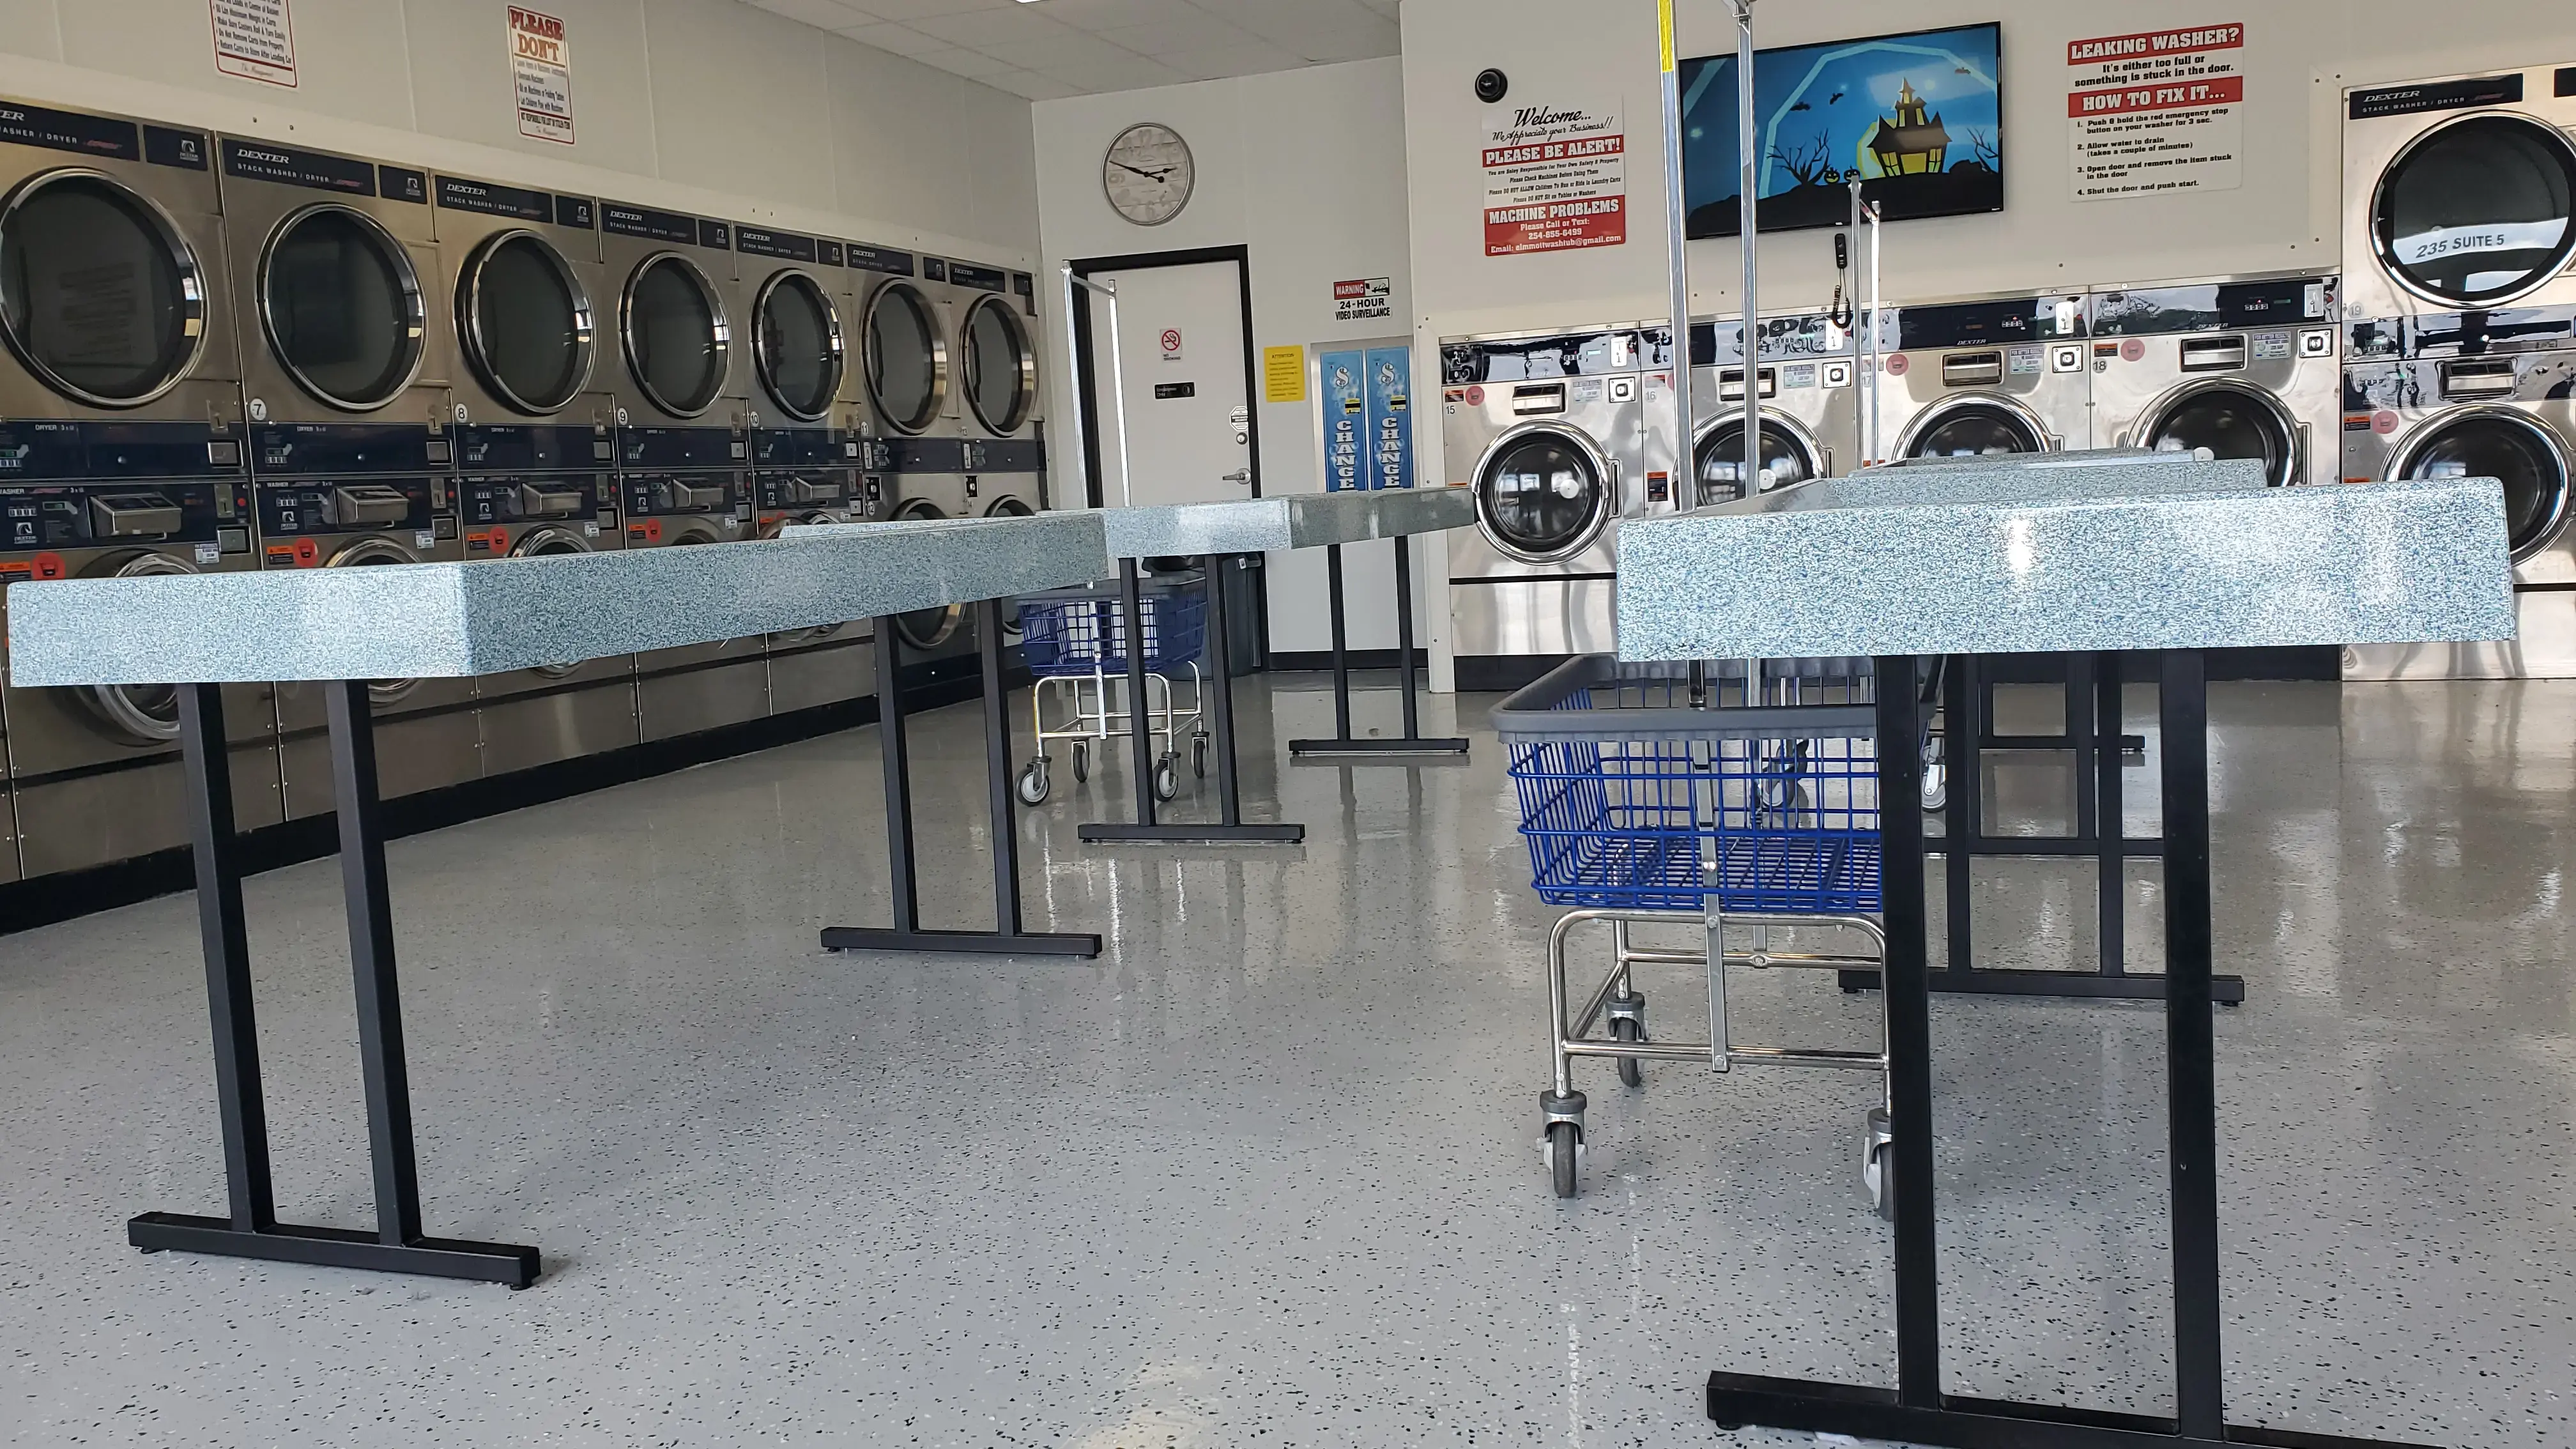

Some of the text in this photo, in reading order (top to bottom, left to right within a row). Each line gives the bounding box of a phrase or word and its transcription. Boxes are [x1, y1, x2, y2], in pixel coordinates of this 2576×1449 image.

[510, 9, 563, 40] PLEASE
[518, 33, 558, 61] DON'T
[2071, 27, 2239, 59] LEAKING WASHER?
[2103, 64, 2119, 73] It's
[2122, 61, 2152, 72] either
[2155, 59, 2171, 68] too
[2174, 56, 2191, 65] full
[2075, 64, 2234, 87] something is stuck in the door.
[2083, 85, 2225, 111] HOW TO FIX IT...
[2363, 90, 2420, 102] DEXTER
[2362, 105, 2389, 113] STACK
[2393, 102, 2427, 110] WASHER
[1514, 105, 1591, 128] Welcome...
[2088, 118, 2106, 126] Push
[2166, 110, 2209, 119] emergency
[47, 133, 77, 144] DRYER
[1492, 132, 1505, 141] We
[1501, 127, 1547, 146] Appreciate
[1549, 128, 1566, 142] your
[1485, 137, 1620, 165] PLEASE BE ALERT!
[2120, 146, 2146, 155] couple
[2158, 142, 2193, 150] minutes)
[236, 148, 289, 164] DEXTER
[237, 163, 263, 173] STACK
[266, 167, 297, 178] WASHER
[306, 174, 329, 183] DRYER
[447, 183, 487, 196] DEXTER
[447, 196, 466, 204] STACK
[468, 199, 492, 208] WASHER
[610, 210, 643, 221] DEXTER
[1489, 199, 1619, 224] MACHINE PROBLEMS
[1520, 222, 1544, 231] Please
[1546, 220, 1560, 229] Call
[1572, 218, 1590, 226] Text:
[743, 232, 770, 242] DEXTER
[2416, 234, 2504, 258] 235 SUITE 5
[853, 249, 876, 258] DEXTER
[1336, 284, 1363, 296] WARNING
[1340, 298, 1384, 309] 24-HOUR
[2350, 305, 2361, 315] 19
[1335, 307, 1390, 321] VIDEO SURVEILLANCE
[2092, 361, 2106, 371] 18
[1645, 391, 1657, 400] 16
[253, 403, 262, 416] 7
[458, 408, 465, 419] 8
[620, 411, 625, 421] 9
[1446, 405, 1455, 415] 15
[751, 415, 758, 424] 10
[862, 425, 868, 433] 11
[1335, 420, 1355, 489] CHANGE
[1380, 417, 1400, 486] CHANGE
